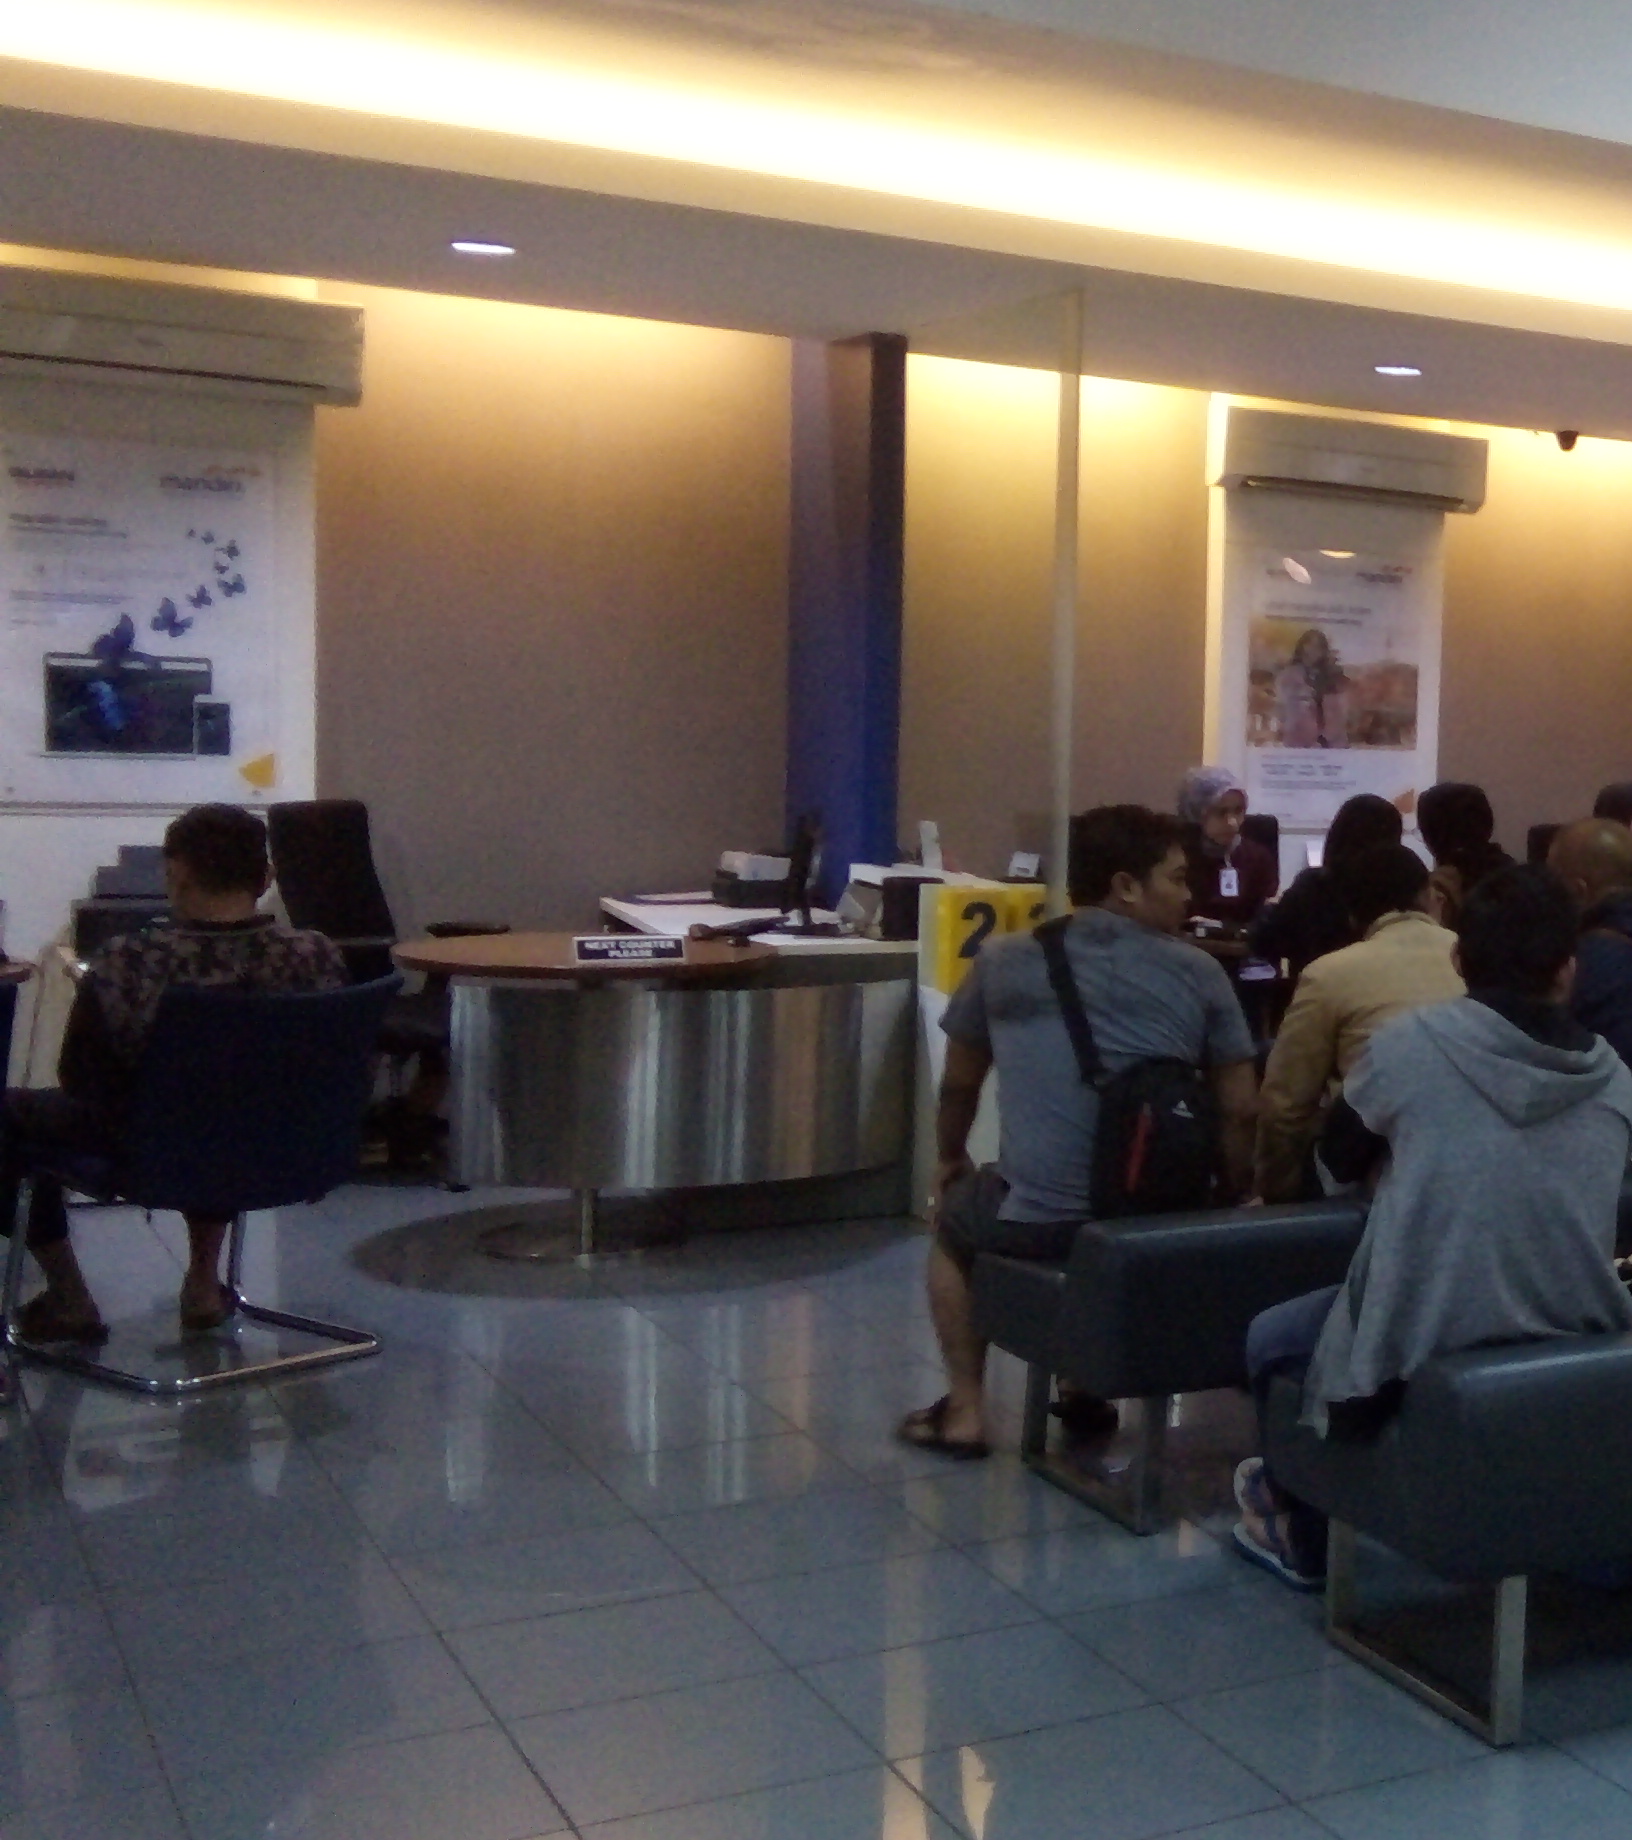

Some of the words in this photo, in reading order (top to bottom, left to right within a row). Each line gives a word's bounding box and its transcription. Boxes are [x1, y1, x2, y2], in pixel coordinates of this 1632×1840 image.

[958, 901, 997, 958] 2
[584, 941, 617, 951] NEXT
[619, 941, 676, 950] COUNTER
[607, 949, 653, 958] PLEASE
